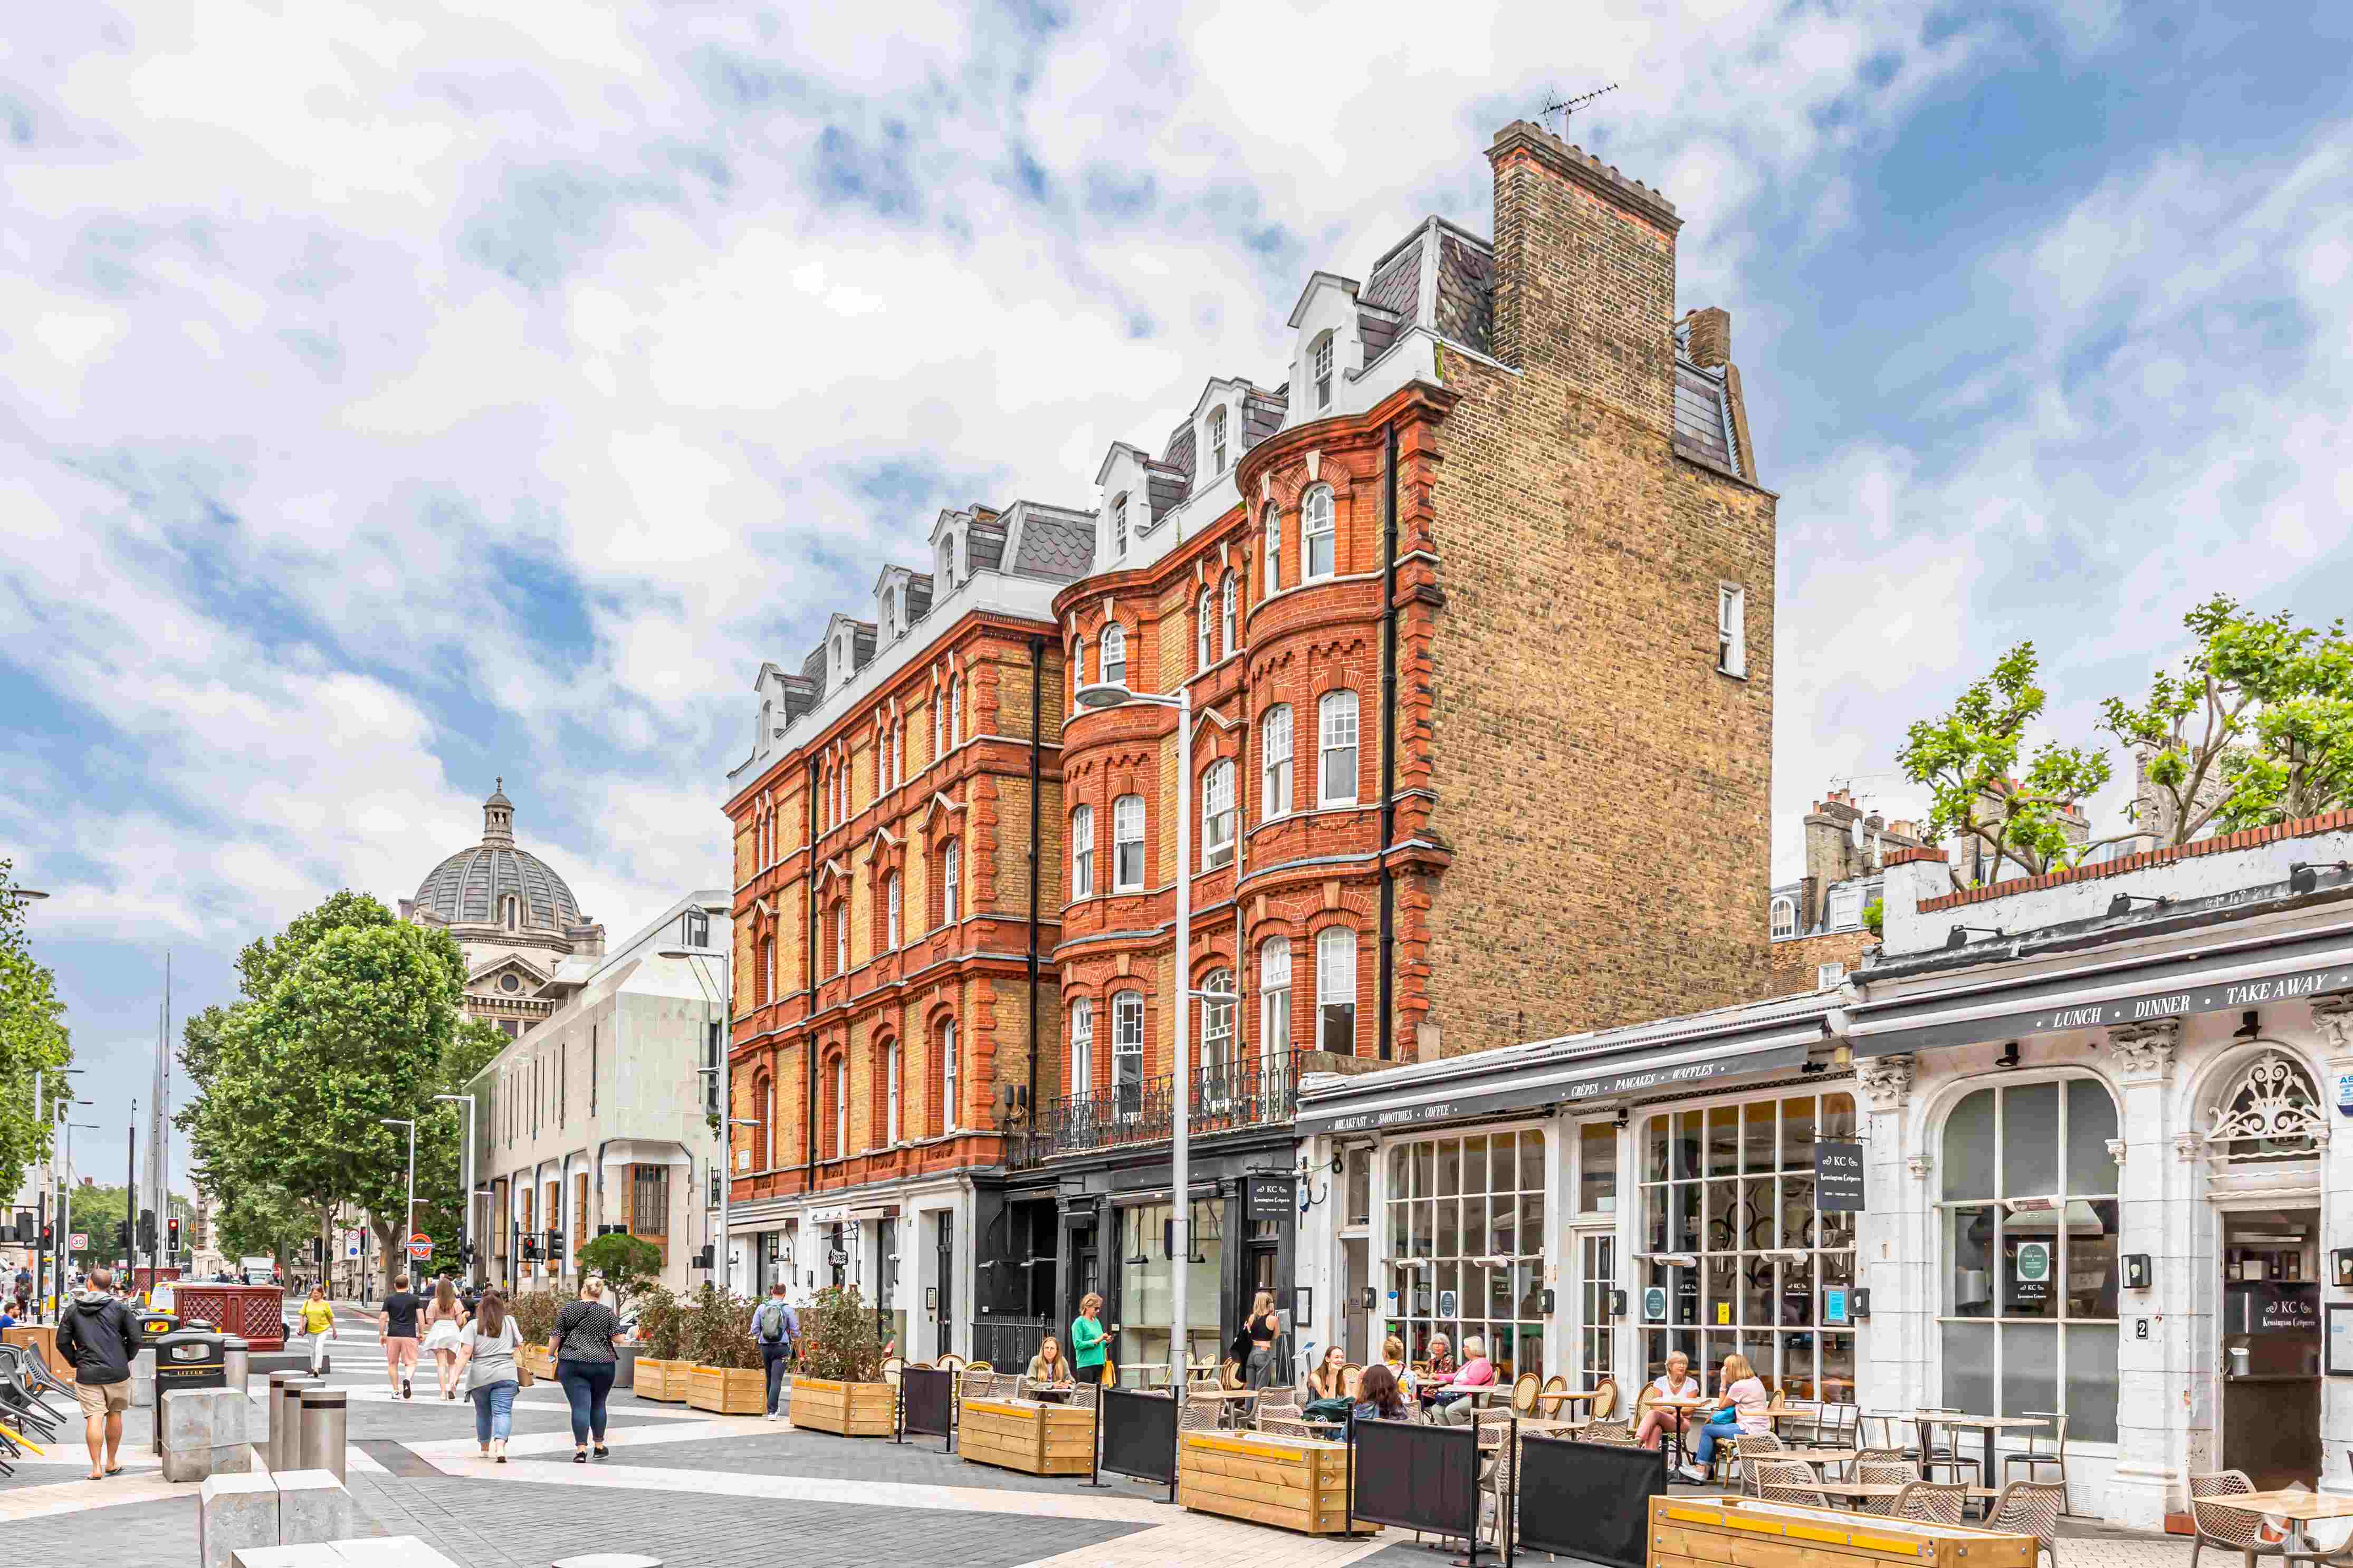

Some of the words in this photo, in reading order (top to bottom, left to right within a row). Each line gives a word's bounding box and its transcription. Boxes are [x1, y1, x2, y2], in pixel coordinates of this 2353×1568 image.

[2053, 1007, 2102, 1028] LUNCH
[2134, 995, 2190, 1018] DINNER
[2227, 982, 2271, 1004] TAKE
[2273, 974, 2328, 997] AWAY
[1614, 1073, 1656, 1091] PANCAKES
[1672, 1064, 1714, 1079] WAFFLES
[1335, 1116, 1367, 1130] BREAKFAST
[1378, 1110, 1412, 1123] SMOOTHIES
[1425, 1104, 1450, 1118] COFFEE
[1834, 1156, 1847, 1166] KC
[2281, 1301, 2297, 1313] KC
[2138, 1322, 2146, 1335] 2
